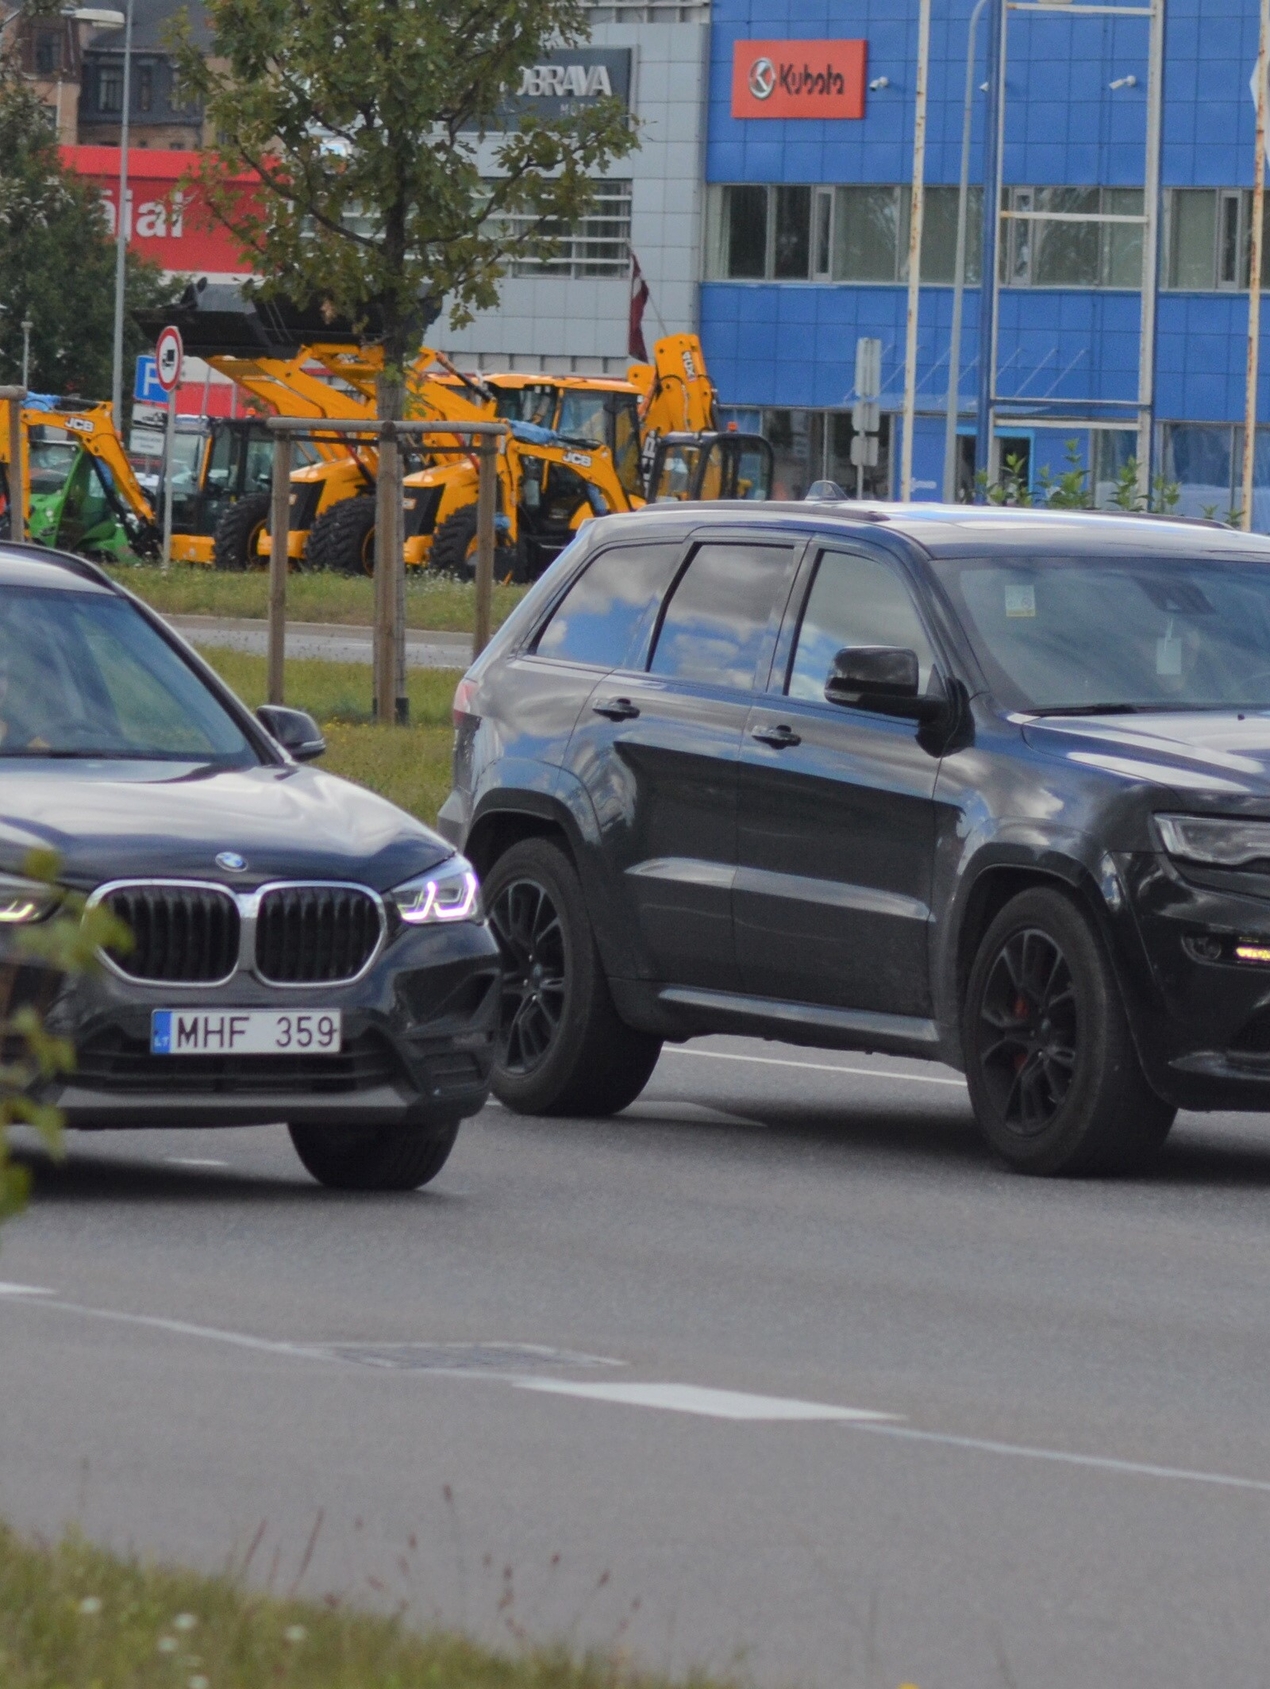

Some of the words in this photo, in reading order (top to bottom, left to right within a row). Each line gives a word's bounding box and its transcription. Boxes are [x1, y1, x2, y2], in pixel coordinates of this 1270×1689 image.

[779, 63, 845, 96] Kubota
[64, 416, 95, 433] JCB
[562, 451, 593, 468] JCB
[177, 1016, 250, 1048] MHF
[276, 1016, 334, 1048] 359
